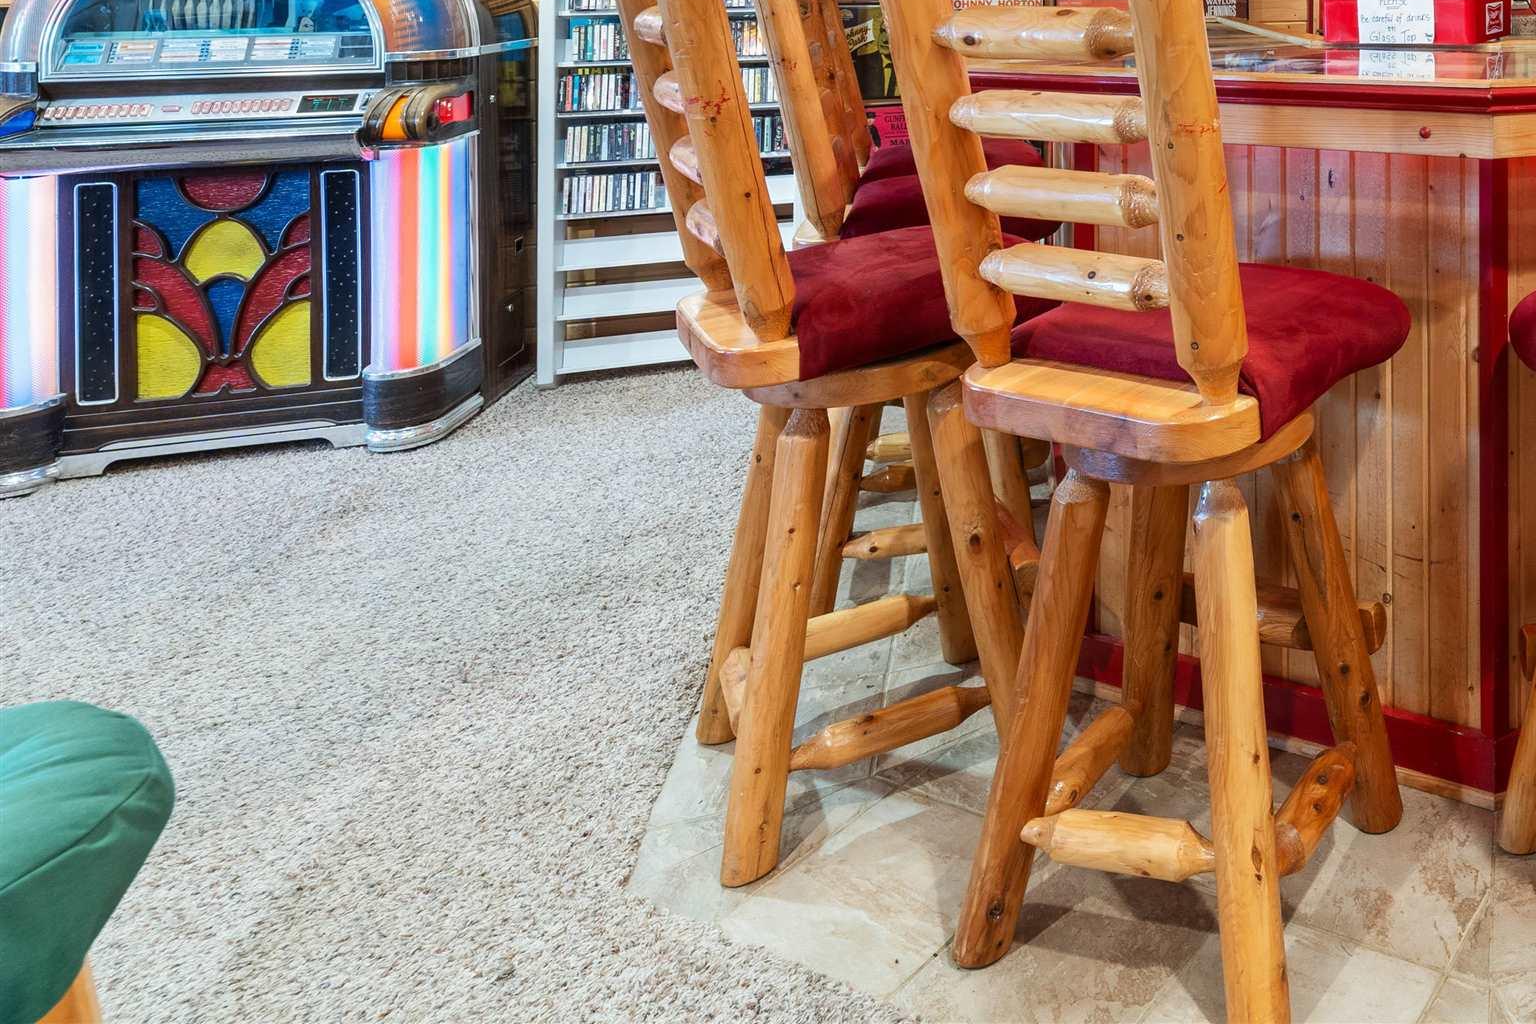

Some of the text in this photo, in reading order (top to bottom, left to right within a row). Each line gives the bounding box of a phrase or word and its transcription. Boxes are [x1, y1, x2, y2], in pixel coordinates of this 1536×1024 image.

[952, 0, 1042, 8] OHNNY HORTON
[1206, 5, 1236, 16] JENNINGS
[1371, 13, 1393, 24] careful
[847, 26, 868, 37] ohnny
[1369, 29, 1417, 43] Glass Top
